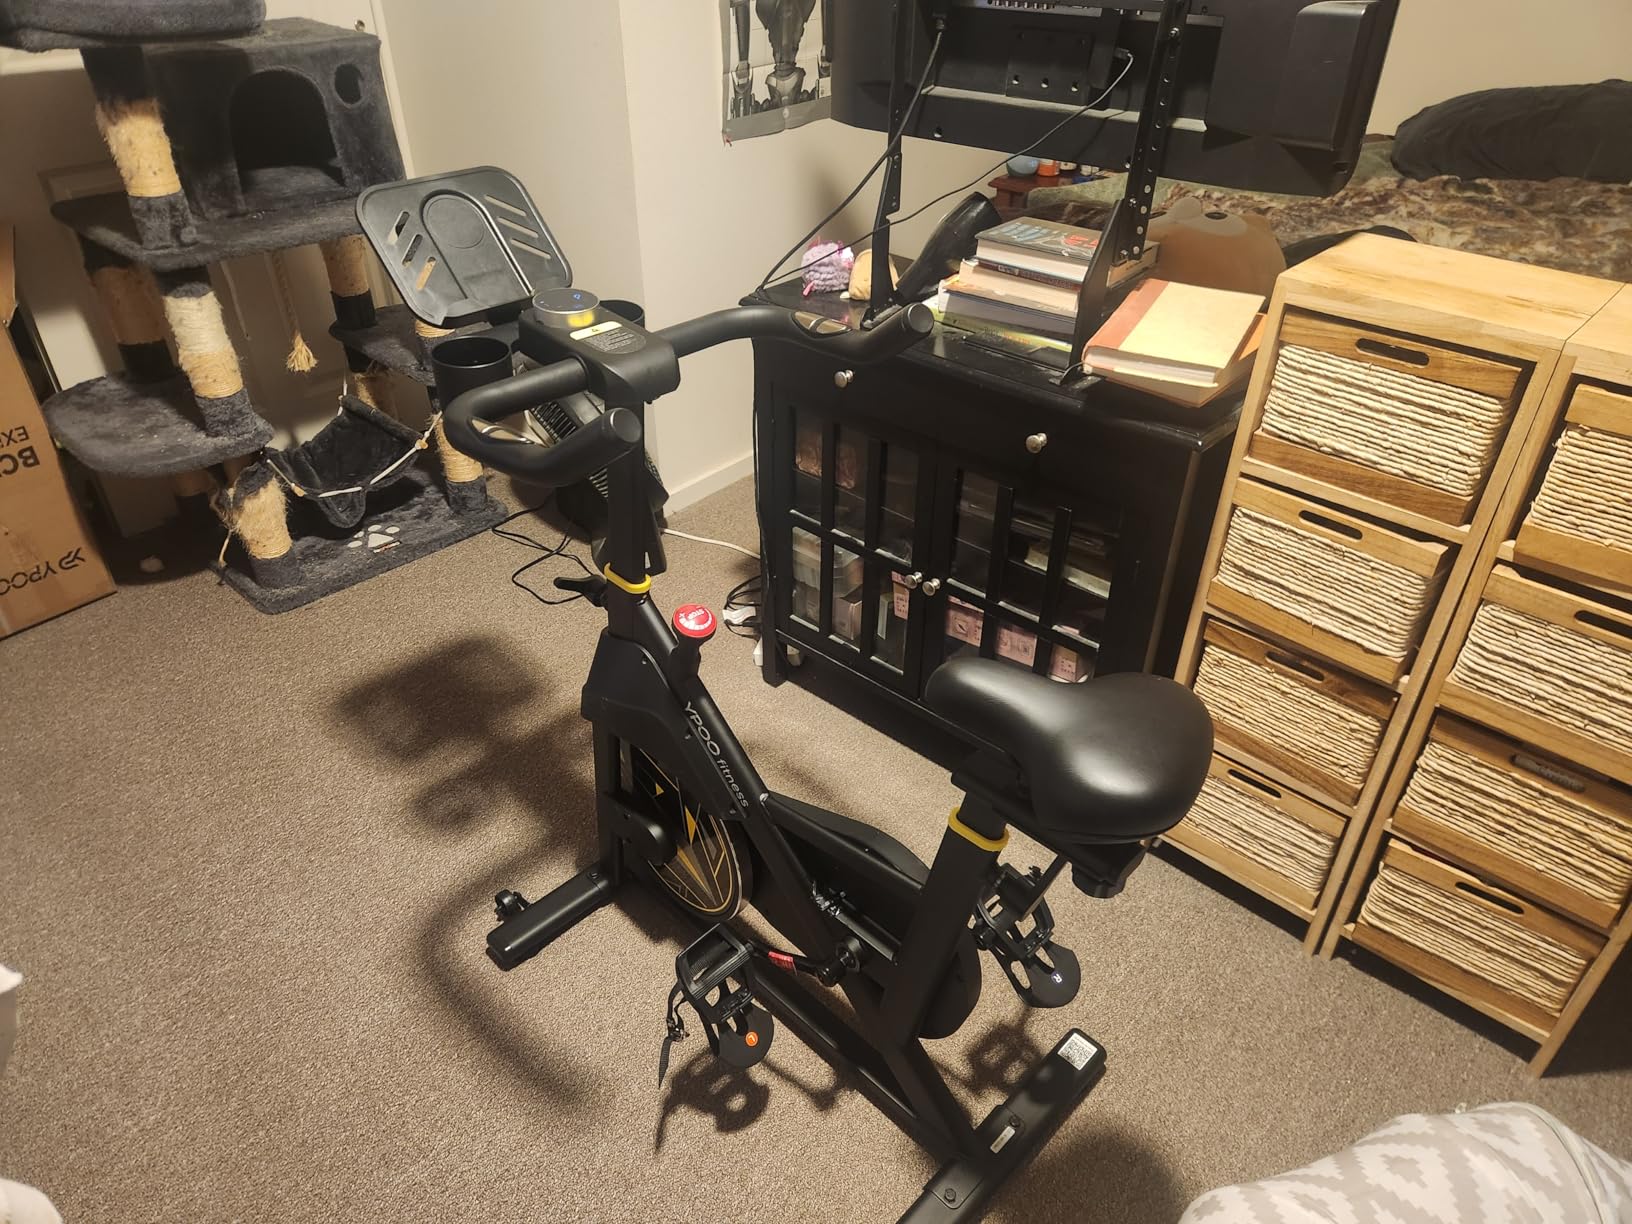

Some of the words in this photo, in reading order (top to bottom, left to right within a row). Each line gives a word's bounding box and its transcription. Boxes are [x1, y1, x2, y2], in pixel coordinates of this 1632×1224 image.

[0, 445, 41, 477] BC
[687, 608, 705, 620] STOP
[684, 701, 721, 757] YPOO
[716, 758, 749, 808] fitness
